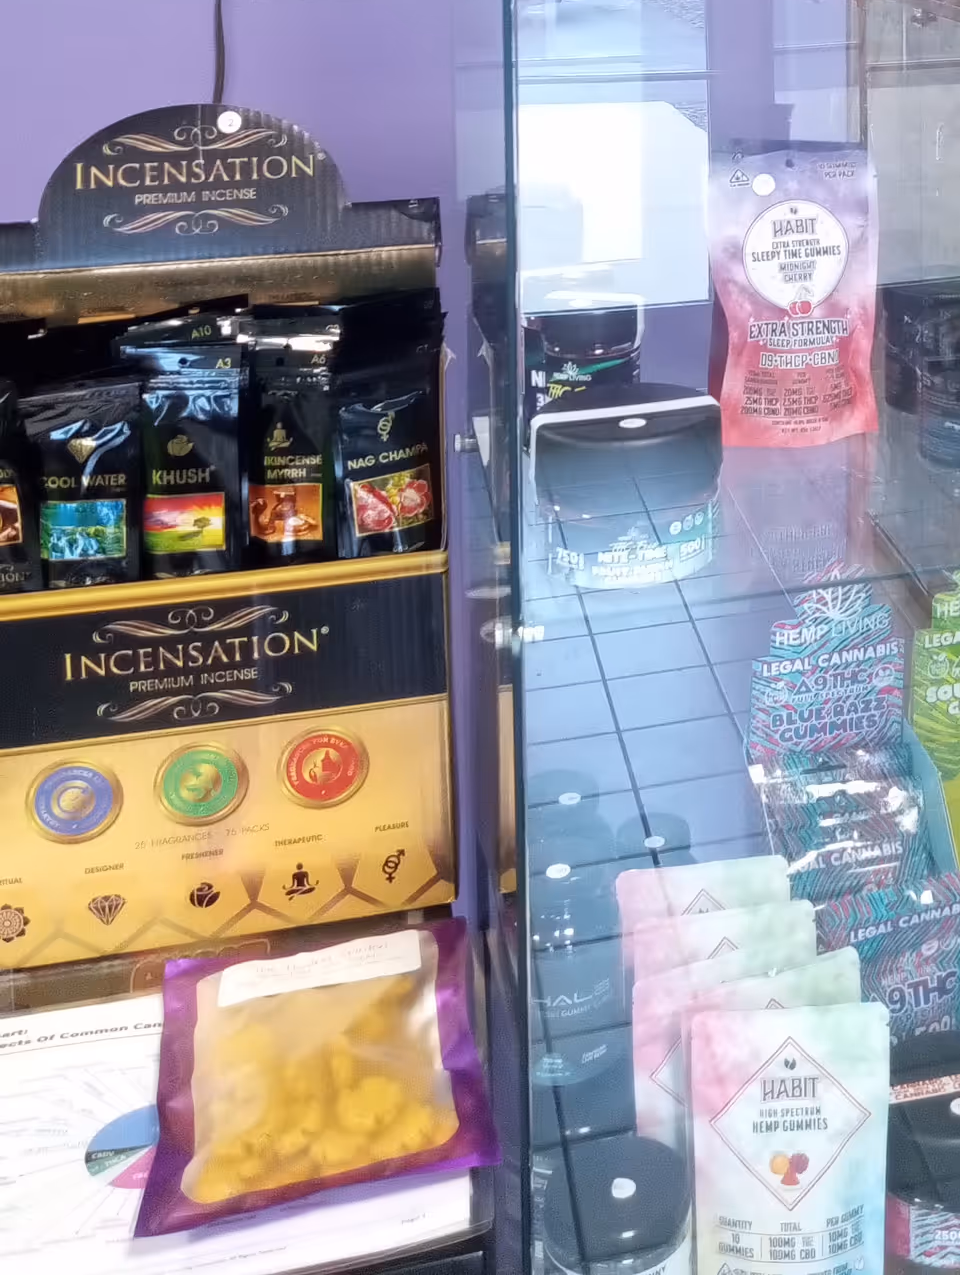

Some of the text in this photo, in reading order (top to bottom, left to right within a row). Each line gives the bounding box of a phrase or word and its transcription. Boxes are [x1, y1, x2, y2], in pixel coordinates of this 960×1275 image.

[134, 188, 257, 205] PREMIUM INCENSE
[772, 218, 817, 237] HABIT
[771, 238, 820, 249] EXTRA STRENGTH
[752, 245, 841, 263] SLEEPY TIME GUMMIES
[779, 261, 816, 272] MIDNIGHT
[784, 273, 813, 283] CHERRY
[191, 325, 212, 340] A10
[749, 320, 849, 339] EXTRA STRENGTH
[768, 336, 833, 349] SLEEP FORMULA
[215, 357, 232, 370] A3
[311, 354, 326, 365] A6
[347, 442, 429, 472] NAG CHAMPA
[267, 467, 307, 479] MYRRH
[82, 474, 127, 489] WATER
[775, 611, 891, 647] HEMP LIVING
[762, 642, 899, 678] LEGAL CANNABIS
[129, 667, 259, 693] PREMIUM INCENSE
[771, 705, 829, 730] BLUE
[779, 713, 881, 744] GUMMIES
[374, 820, 410, 832] PLEASURE
[274, 833, 324, 847] THERAPEUTIC
[181, 848, 225, 861] FRESHENER
[830, 841, 903, 870] CANNABIS
[84, 862, 125, 875] DESIGNER
[849, 924, 894, 944] LEGAL
[36, 1033, 56, 1043] Of
[60, 1025, 128, 1039] Common
[133, 1021, 162, 1031] Can
[762, 1077, 819, 1102] HABIT
[759, 1106, 821, 1119] HIGH SPECTRUM
[752, 1117, 829, 1134] HEMP GUMMIES
[718, 1215, 753, 1231] QUANTITY
[780, 1222, 802, 1232] TOTAL
[826, 1215, 840, 1228] PER
[731, 1232, 740, 1244] 10
[769, 1236, 796, 1248] 100MG
[828, 1229, 849, 1243] 10MG
[718, 1242, 754, 1259] GUMMIES
[769, 1248, 816, 1261] 100MG CBD
[828, 1240, 849, 1255] 10MG
